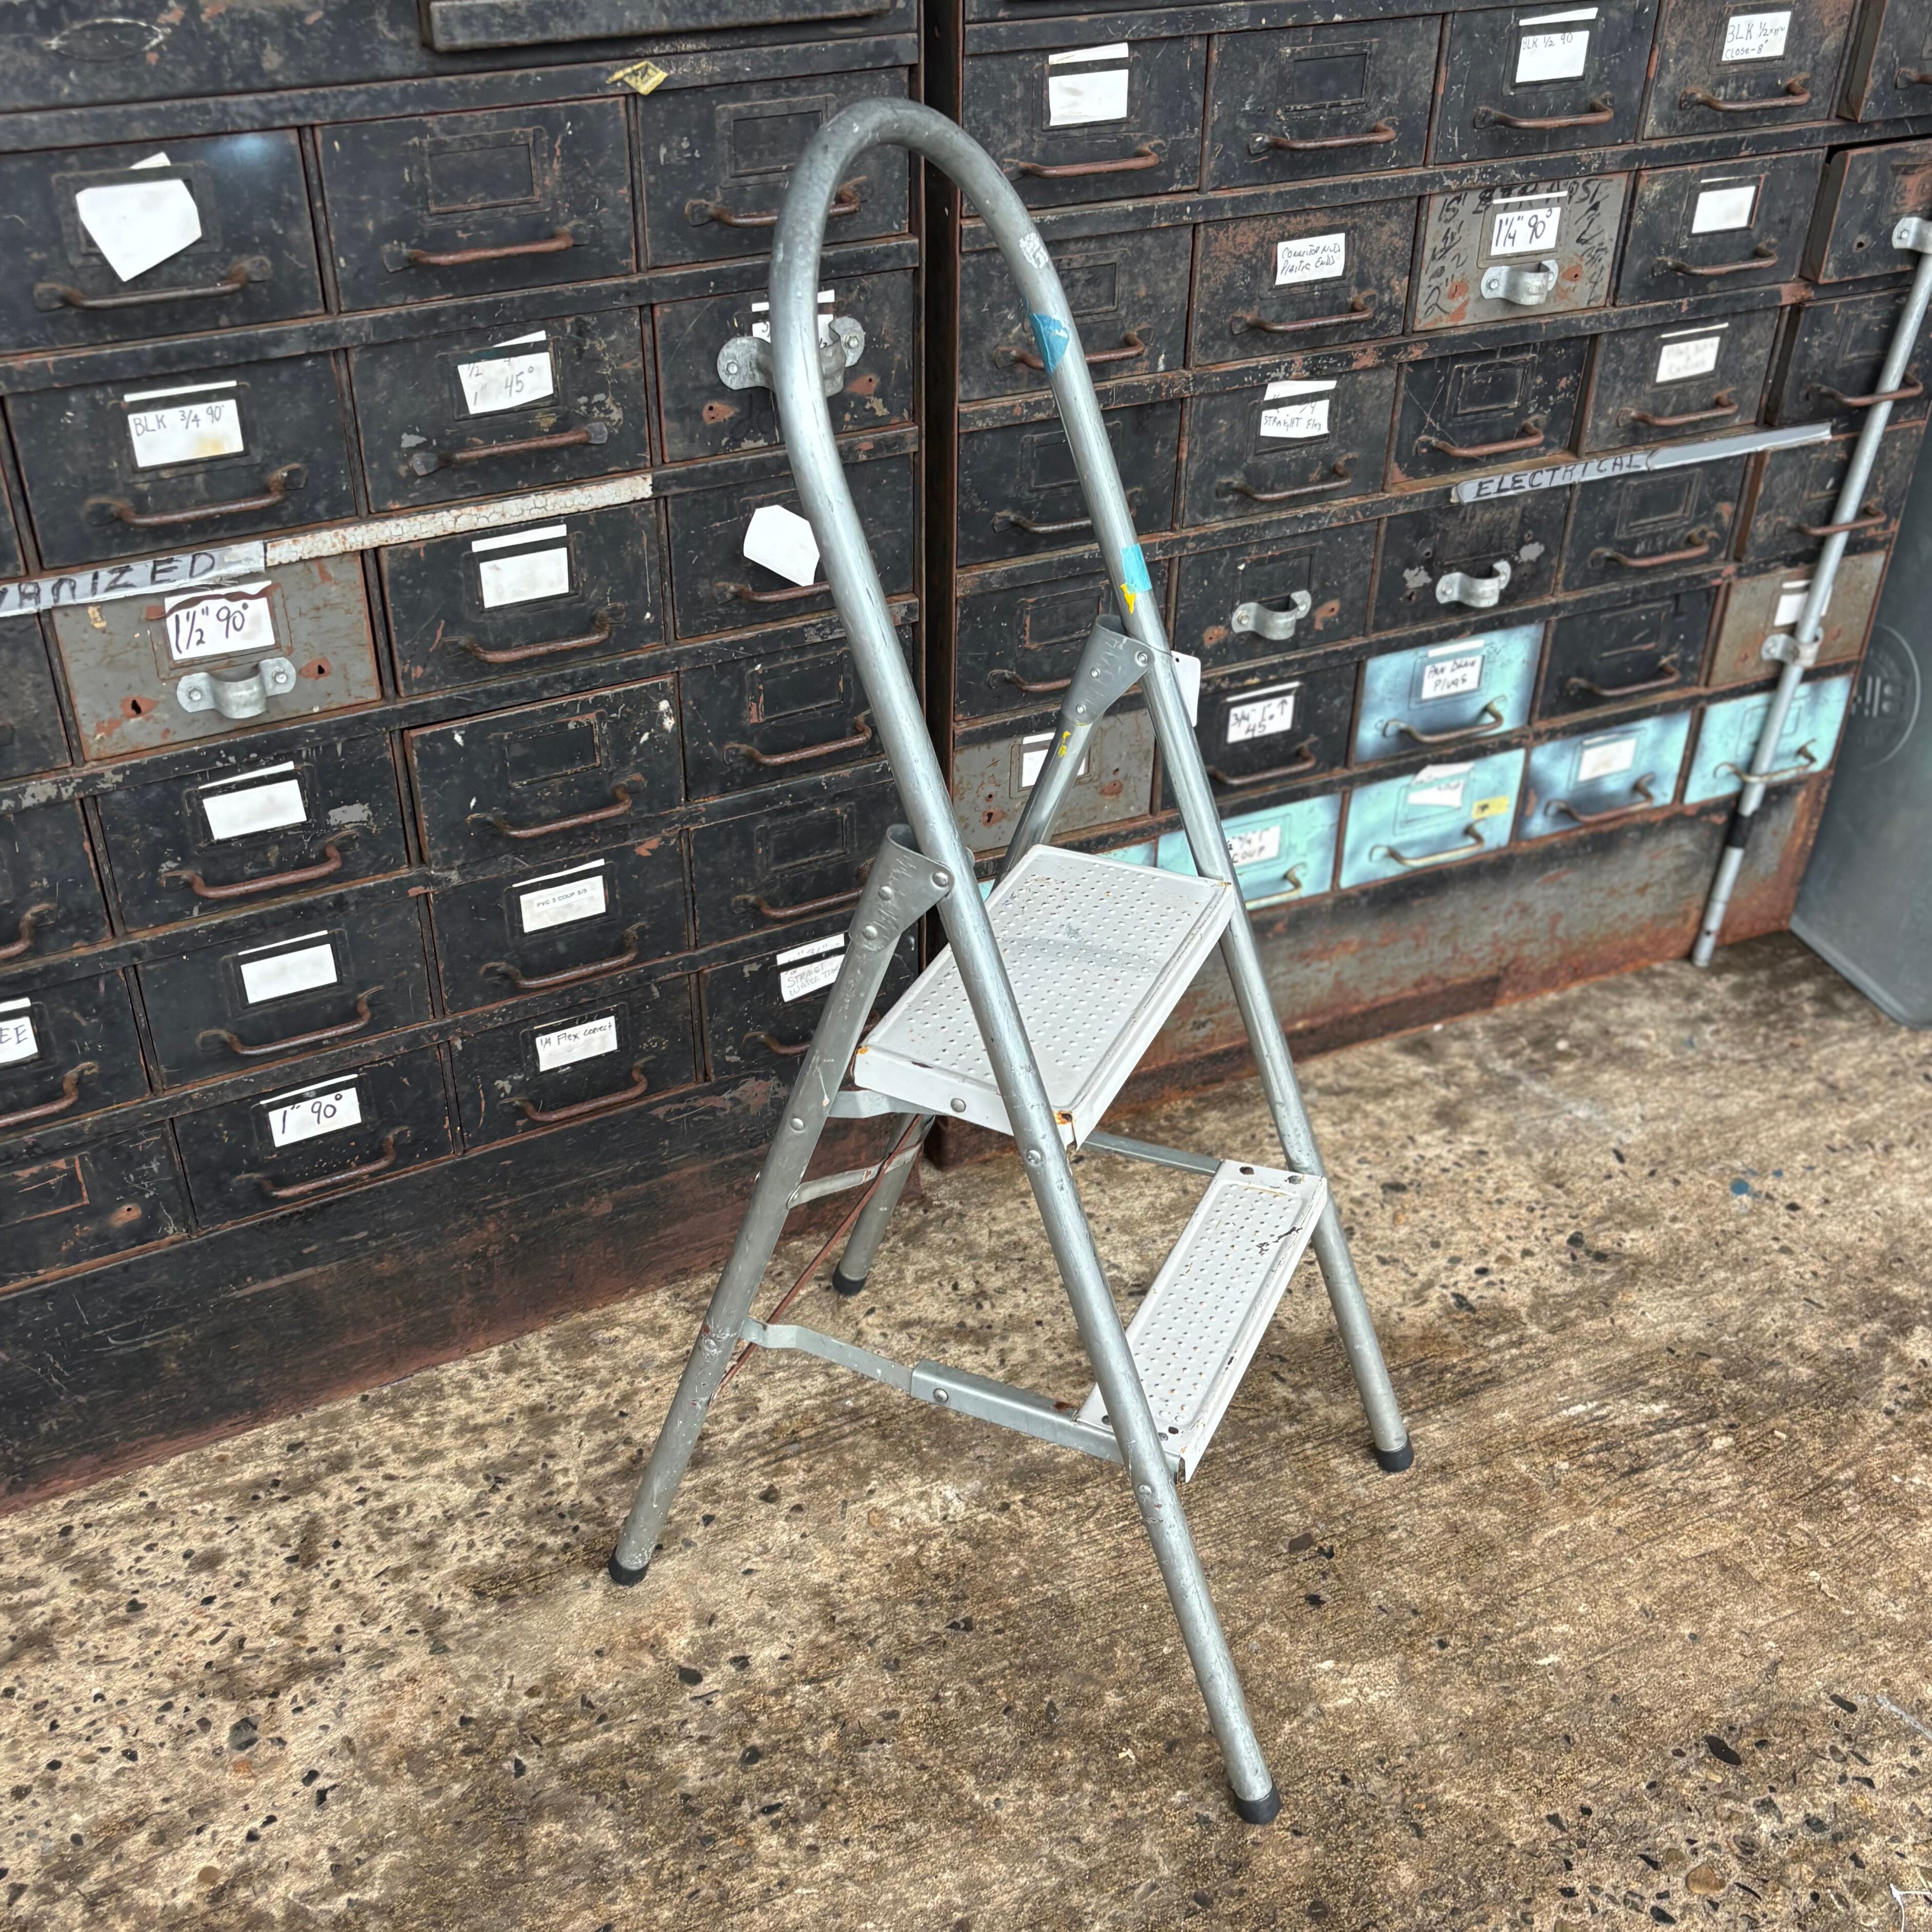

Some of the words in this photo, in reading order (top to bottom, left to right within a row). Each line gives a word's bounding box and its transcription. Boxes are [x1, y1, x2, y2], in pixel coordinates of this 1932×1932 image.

[1523, 36, 1538, 50] BLK
[1561, 32, 1573, 45] 90
[1727, 23, 1754, 43] BLK
[133, 415, 167, 436] BLK
[179, 410, 201, 430] 3/4
[1473, 454, 1641, 498] ELECTRICAL
